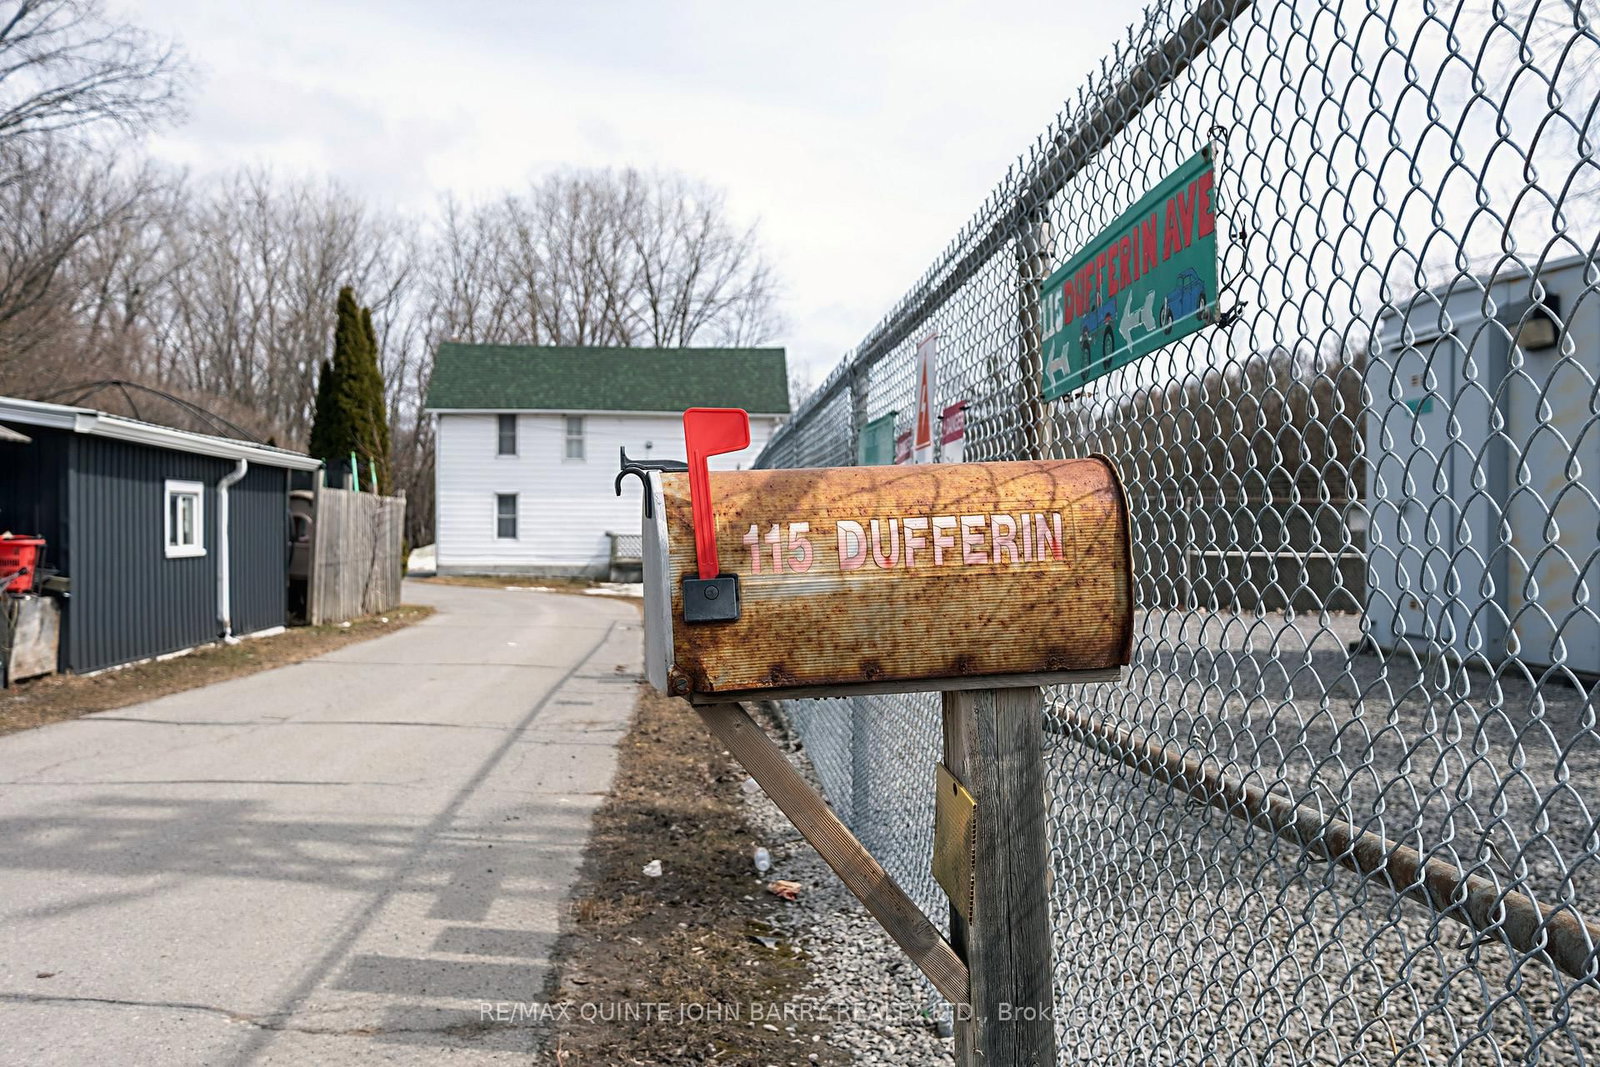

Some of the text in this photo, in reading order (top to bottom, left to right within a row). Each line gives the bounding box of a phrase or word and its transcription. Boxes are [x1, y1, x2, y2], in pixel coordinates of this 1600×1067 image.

[1063, 212, 1159, 325] DUFFERIN
[1162, 169, 1215, 262] AVE
[742, 511, 1064, 575] 115 DUFFERIN
